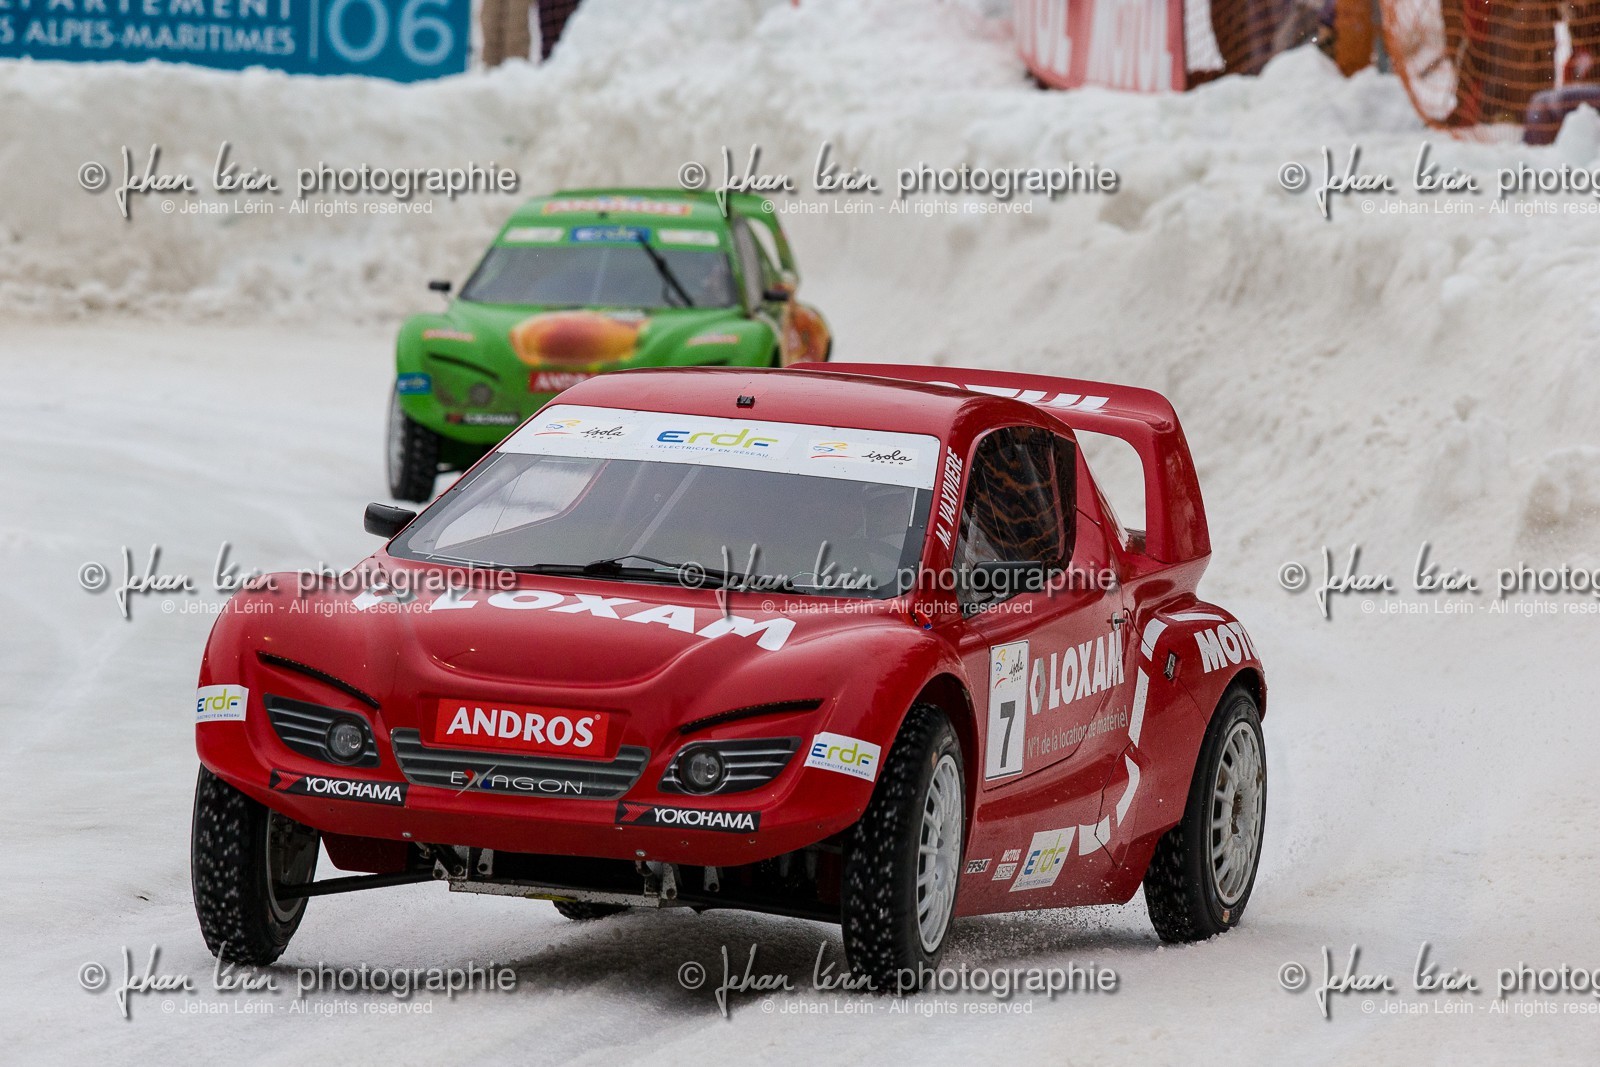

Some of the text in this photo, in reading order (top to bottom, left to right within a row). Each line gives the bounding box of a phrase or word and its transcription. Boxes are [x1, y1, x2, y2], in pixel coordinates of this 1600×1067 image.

[25, 18, 296, 54] ALPES-MARITIMES
[327, 0, 454, 66] 06
[580, 424, 625, 437] isola
[862, 449, 912, 462] isola
[936, 523, 952, 550] M.
[431, 588, 797, 652] LOXAM
[1048, 629, 1124, 710] LOXAM
[1000, 700, 1016, 769] 7
[1041, 735, 1051, 753] de
[1051, 729, 1058, 750] la
[1059, 722, 1087, 748] location
[305, 776, 402, 802] YOKOHAMA
[450, 763, 583, 797] EXAGON
[654, 807, 755, 831] YOKOHAMA
[966, 859, 989, 873] FFSA
